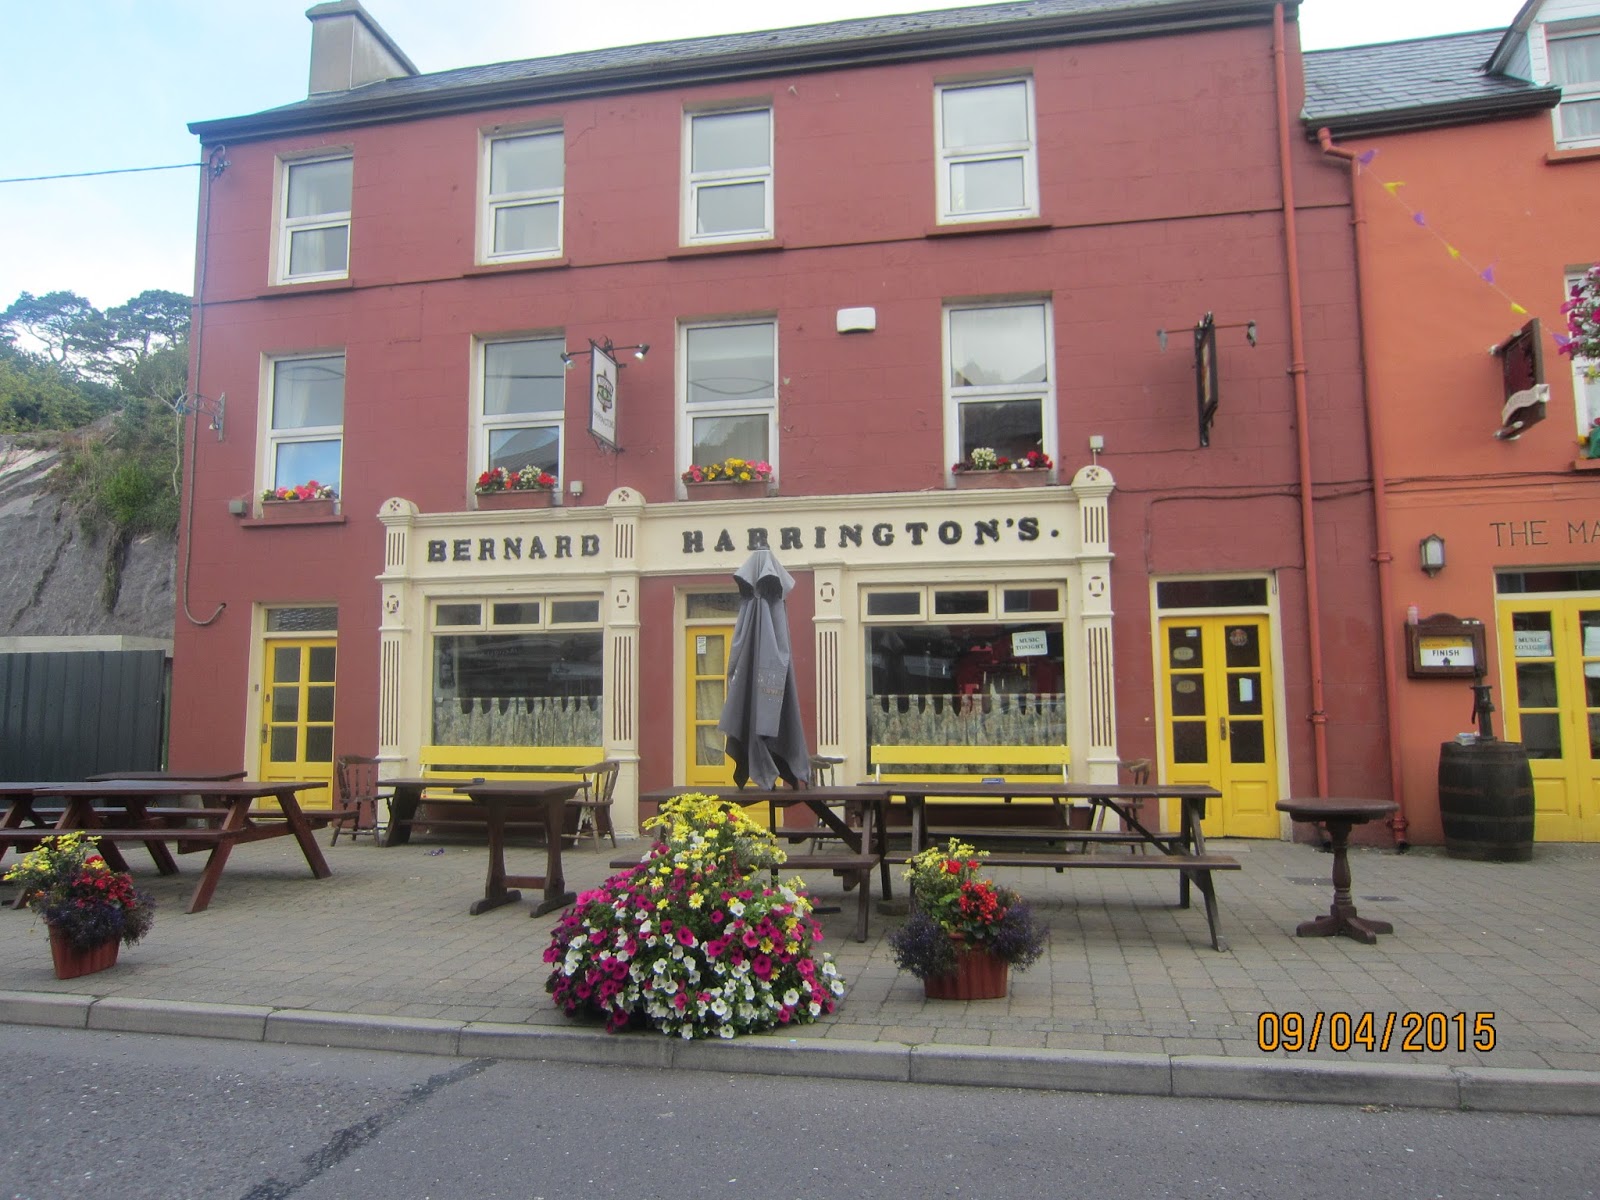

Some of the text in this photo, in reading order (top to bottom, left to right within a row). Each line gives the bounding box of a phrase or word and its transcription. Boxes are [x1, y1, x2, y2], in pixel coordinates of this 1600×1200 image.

[1489, 520, 1548, 546] THE
[427, 534, 600, 562] BERNARD
[1432, 649, 1460, 657] FINISH
